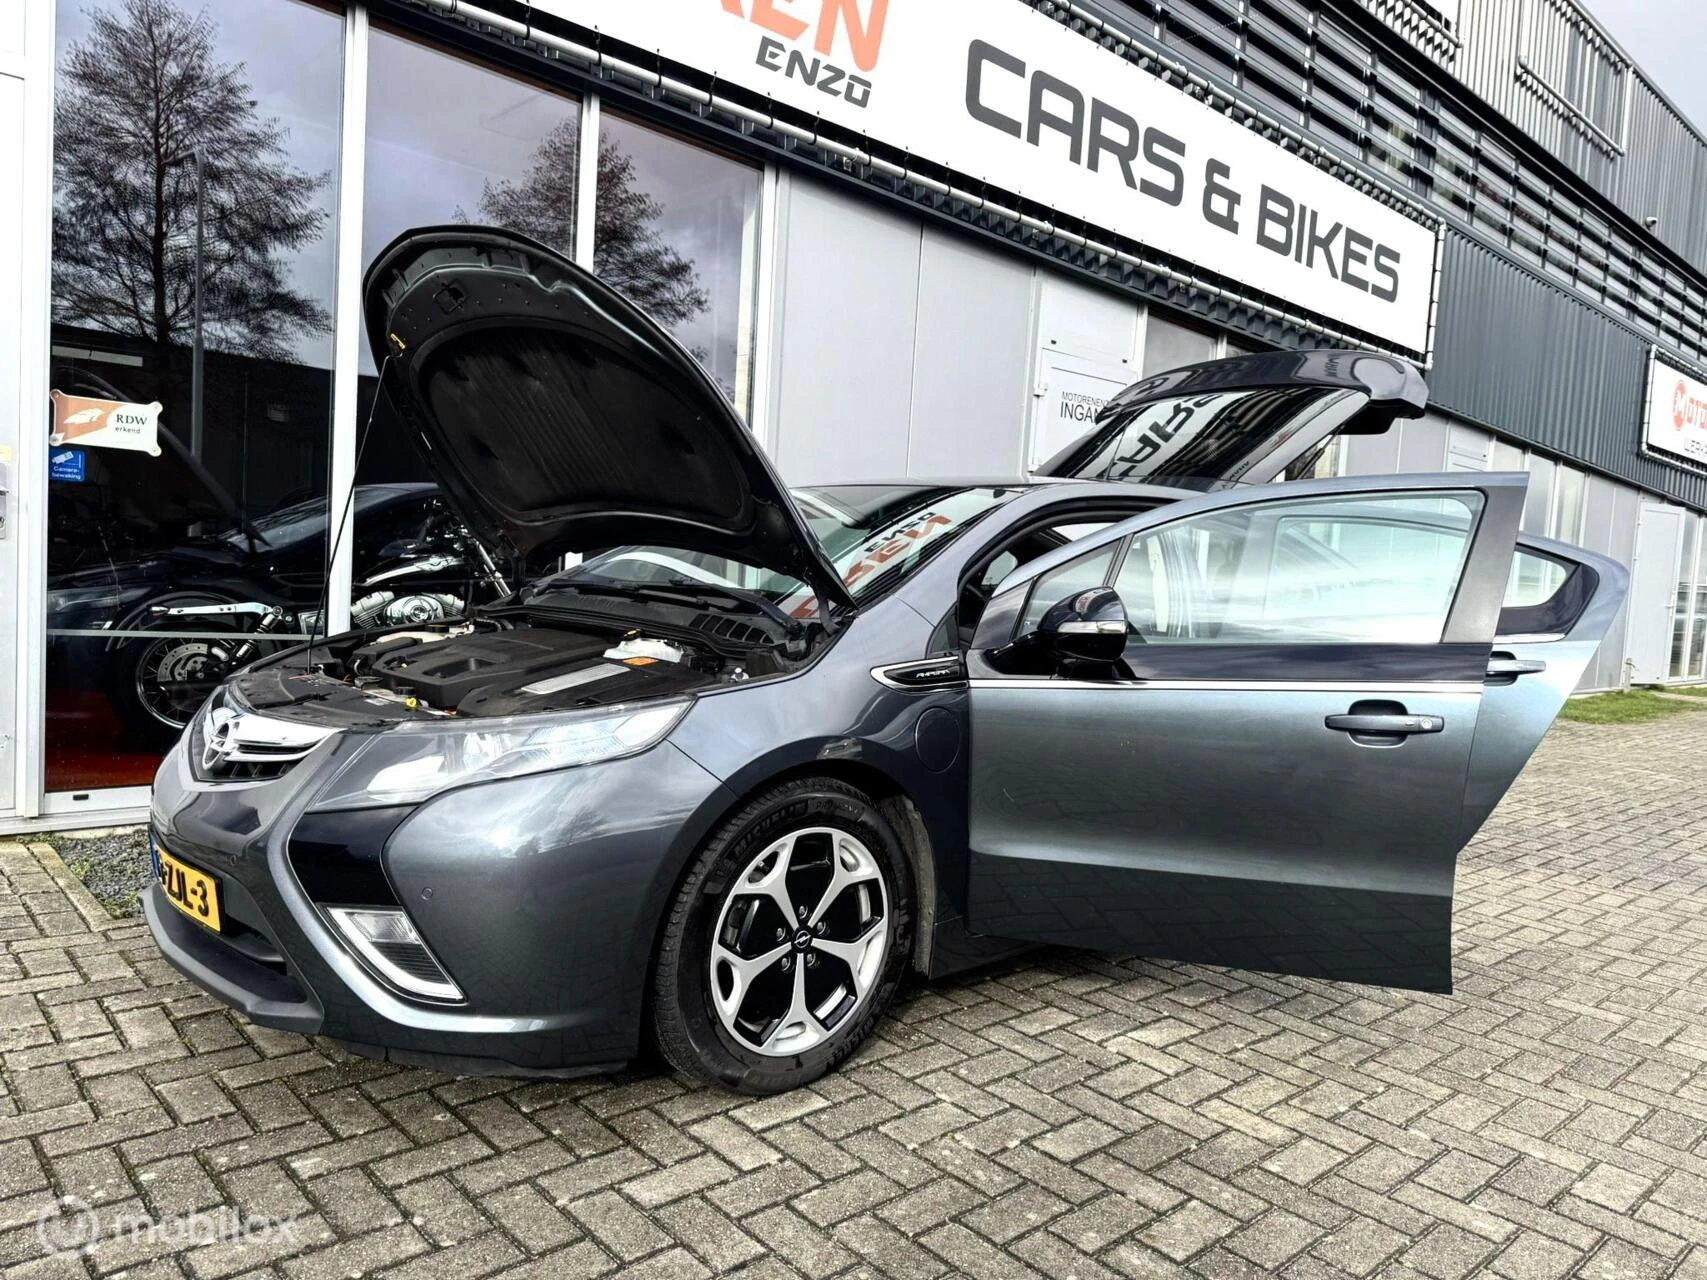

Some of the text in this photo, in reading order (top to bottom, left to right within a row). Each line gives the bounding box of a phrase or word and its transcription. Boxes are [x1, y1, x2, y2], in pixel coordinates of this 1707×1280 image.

[755, 36, 873, 109] ENZO
[965, 38, 1401, 304] CARS & BIKES
[117, 414, 147, 425] RDW
